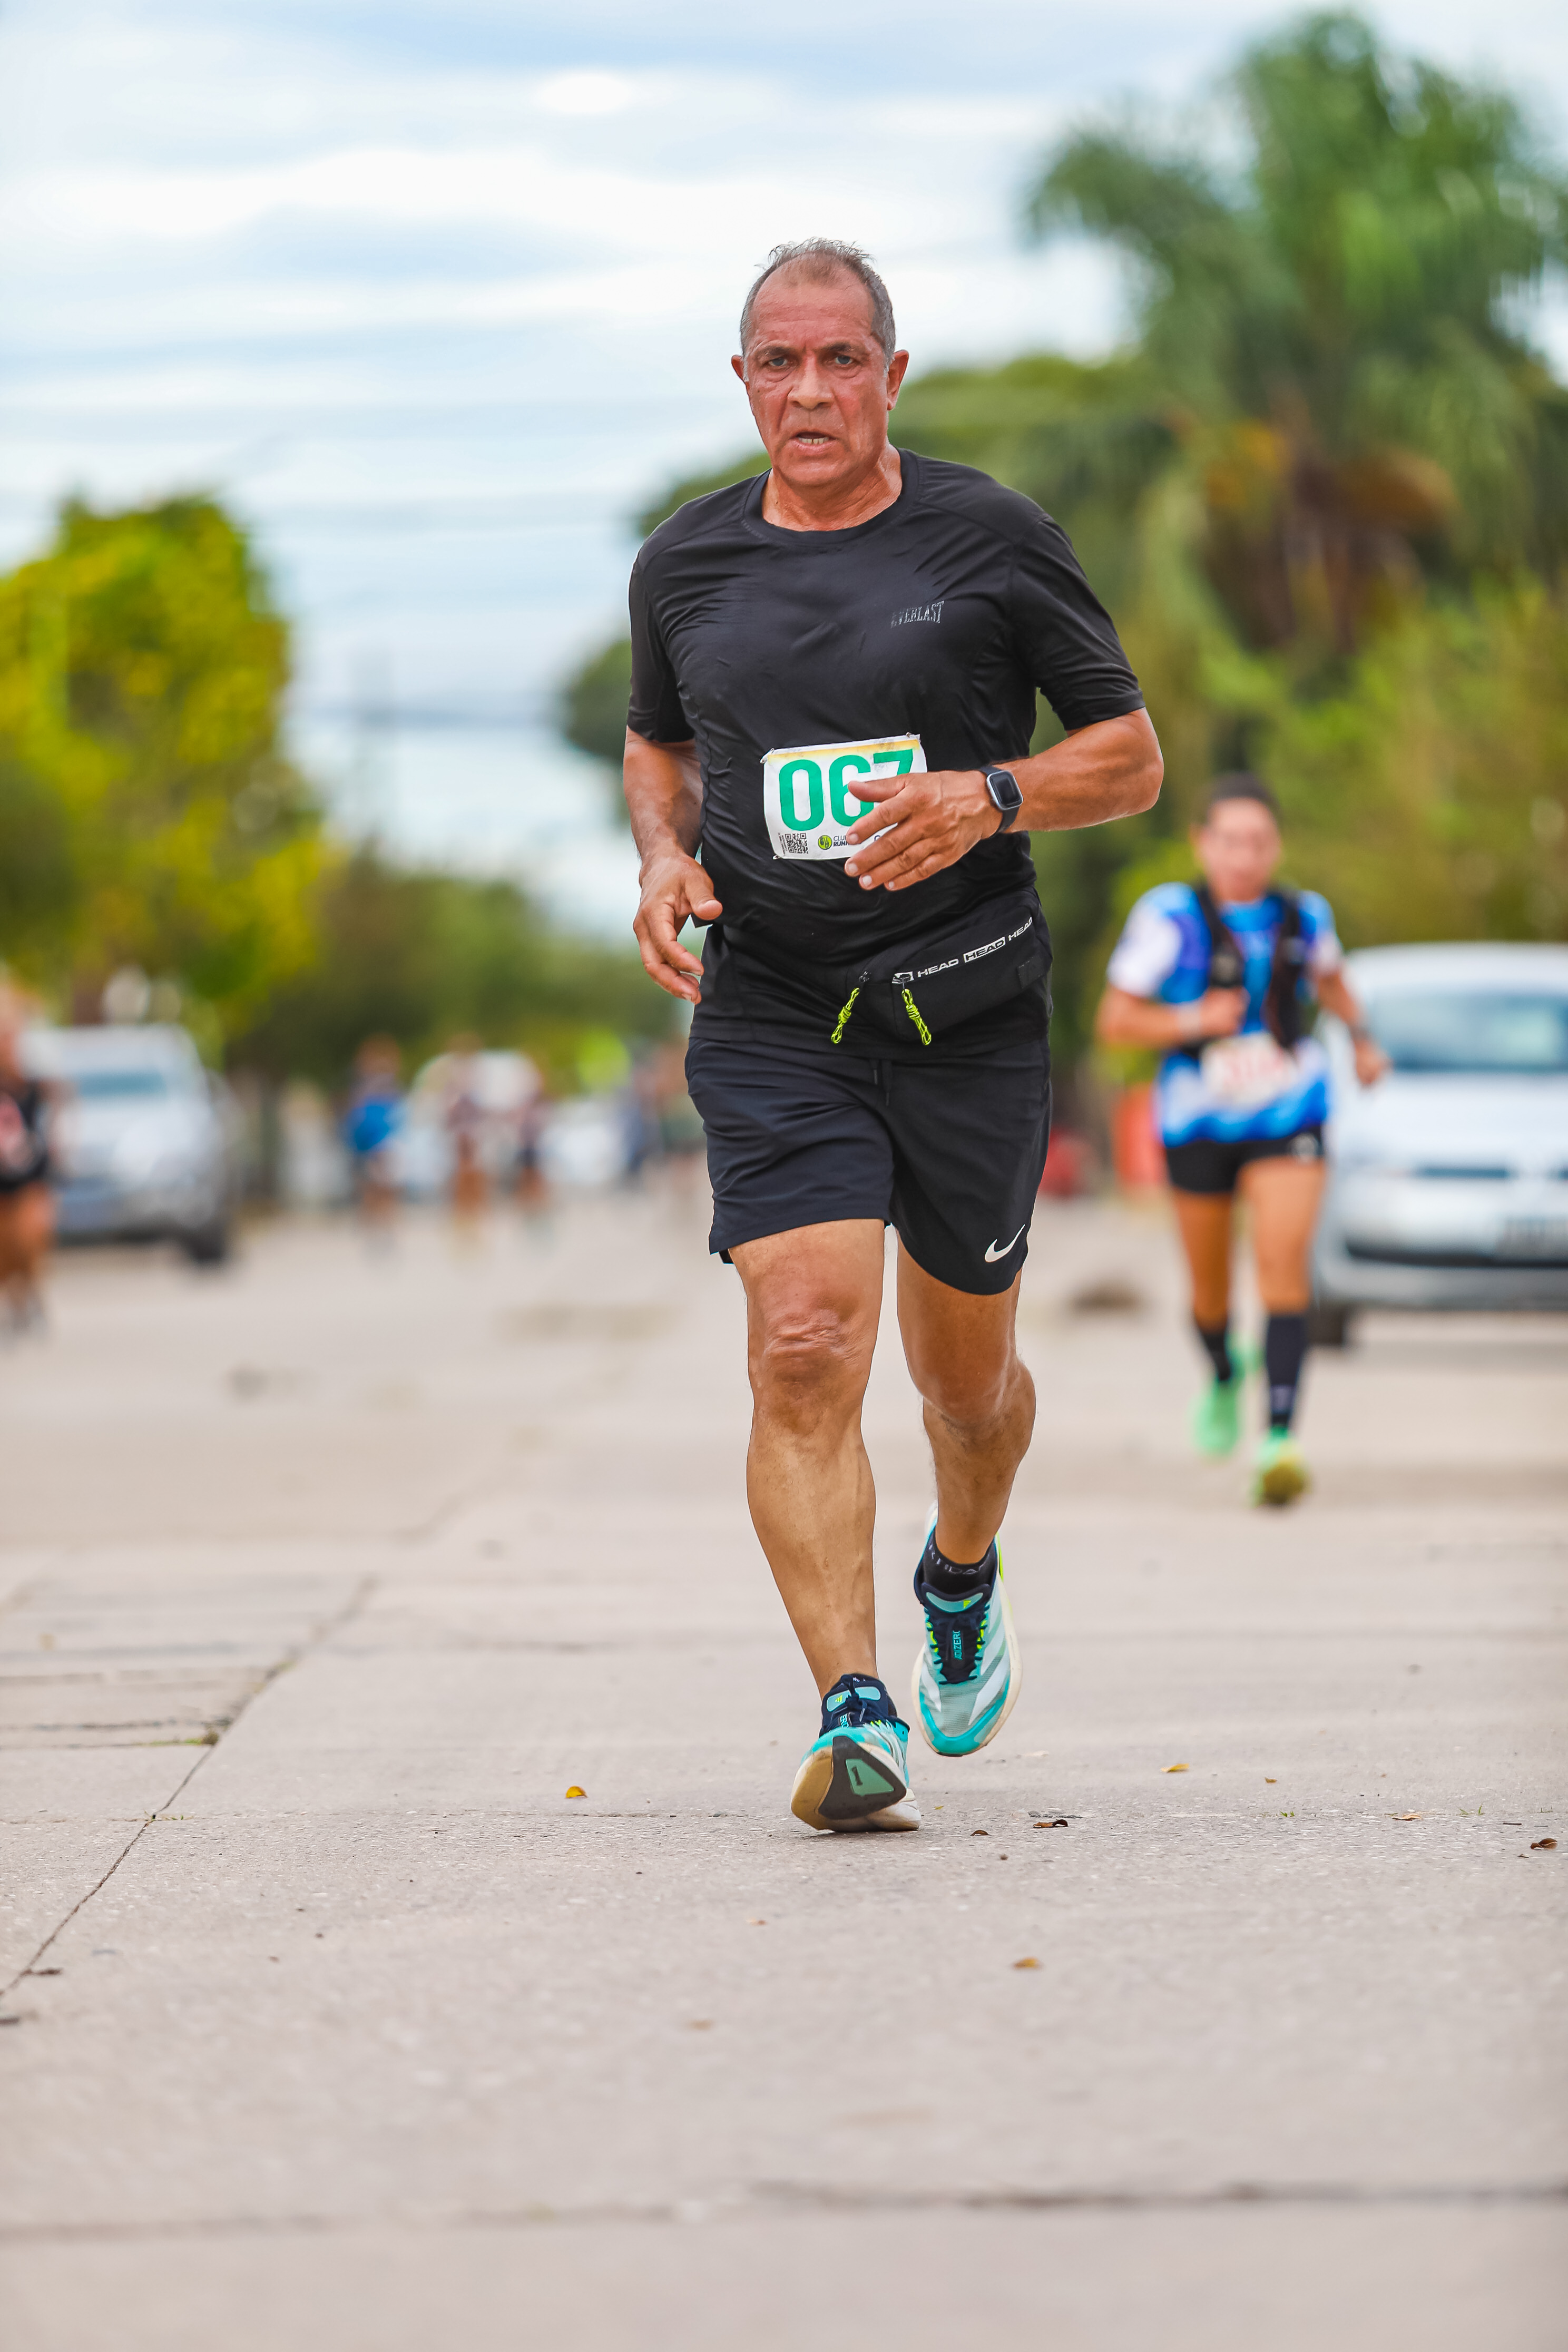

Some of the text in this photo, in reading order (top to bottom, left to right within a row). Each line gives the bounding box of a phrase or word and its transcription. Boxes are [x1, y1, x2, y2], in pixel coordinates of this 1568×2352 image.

[917, 916, 1033, 977] HEAD HEAD HEAD
